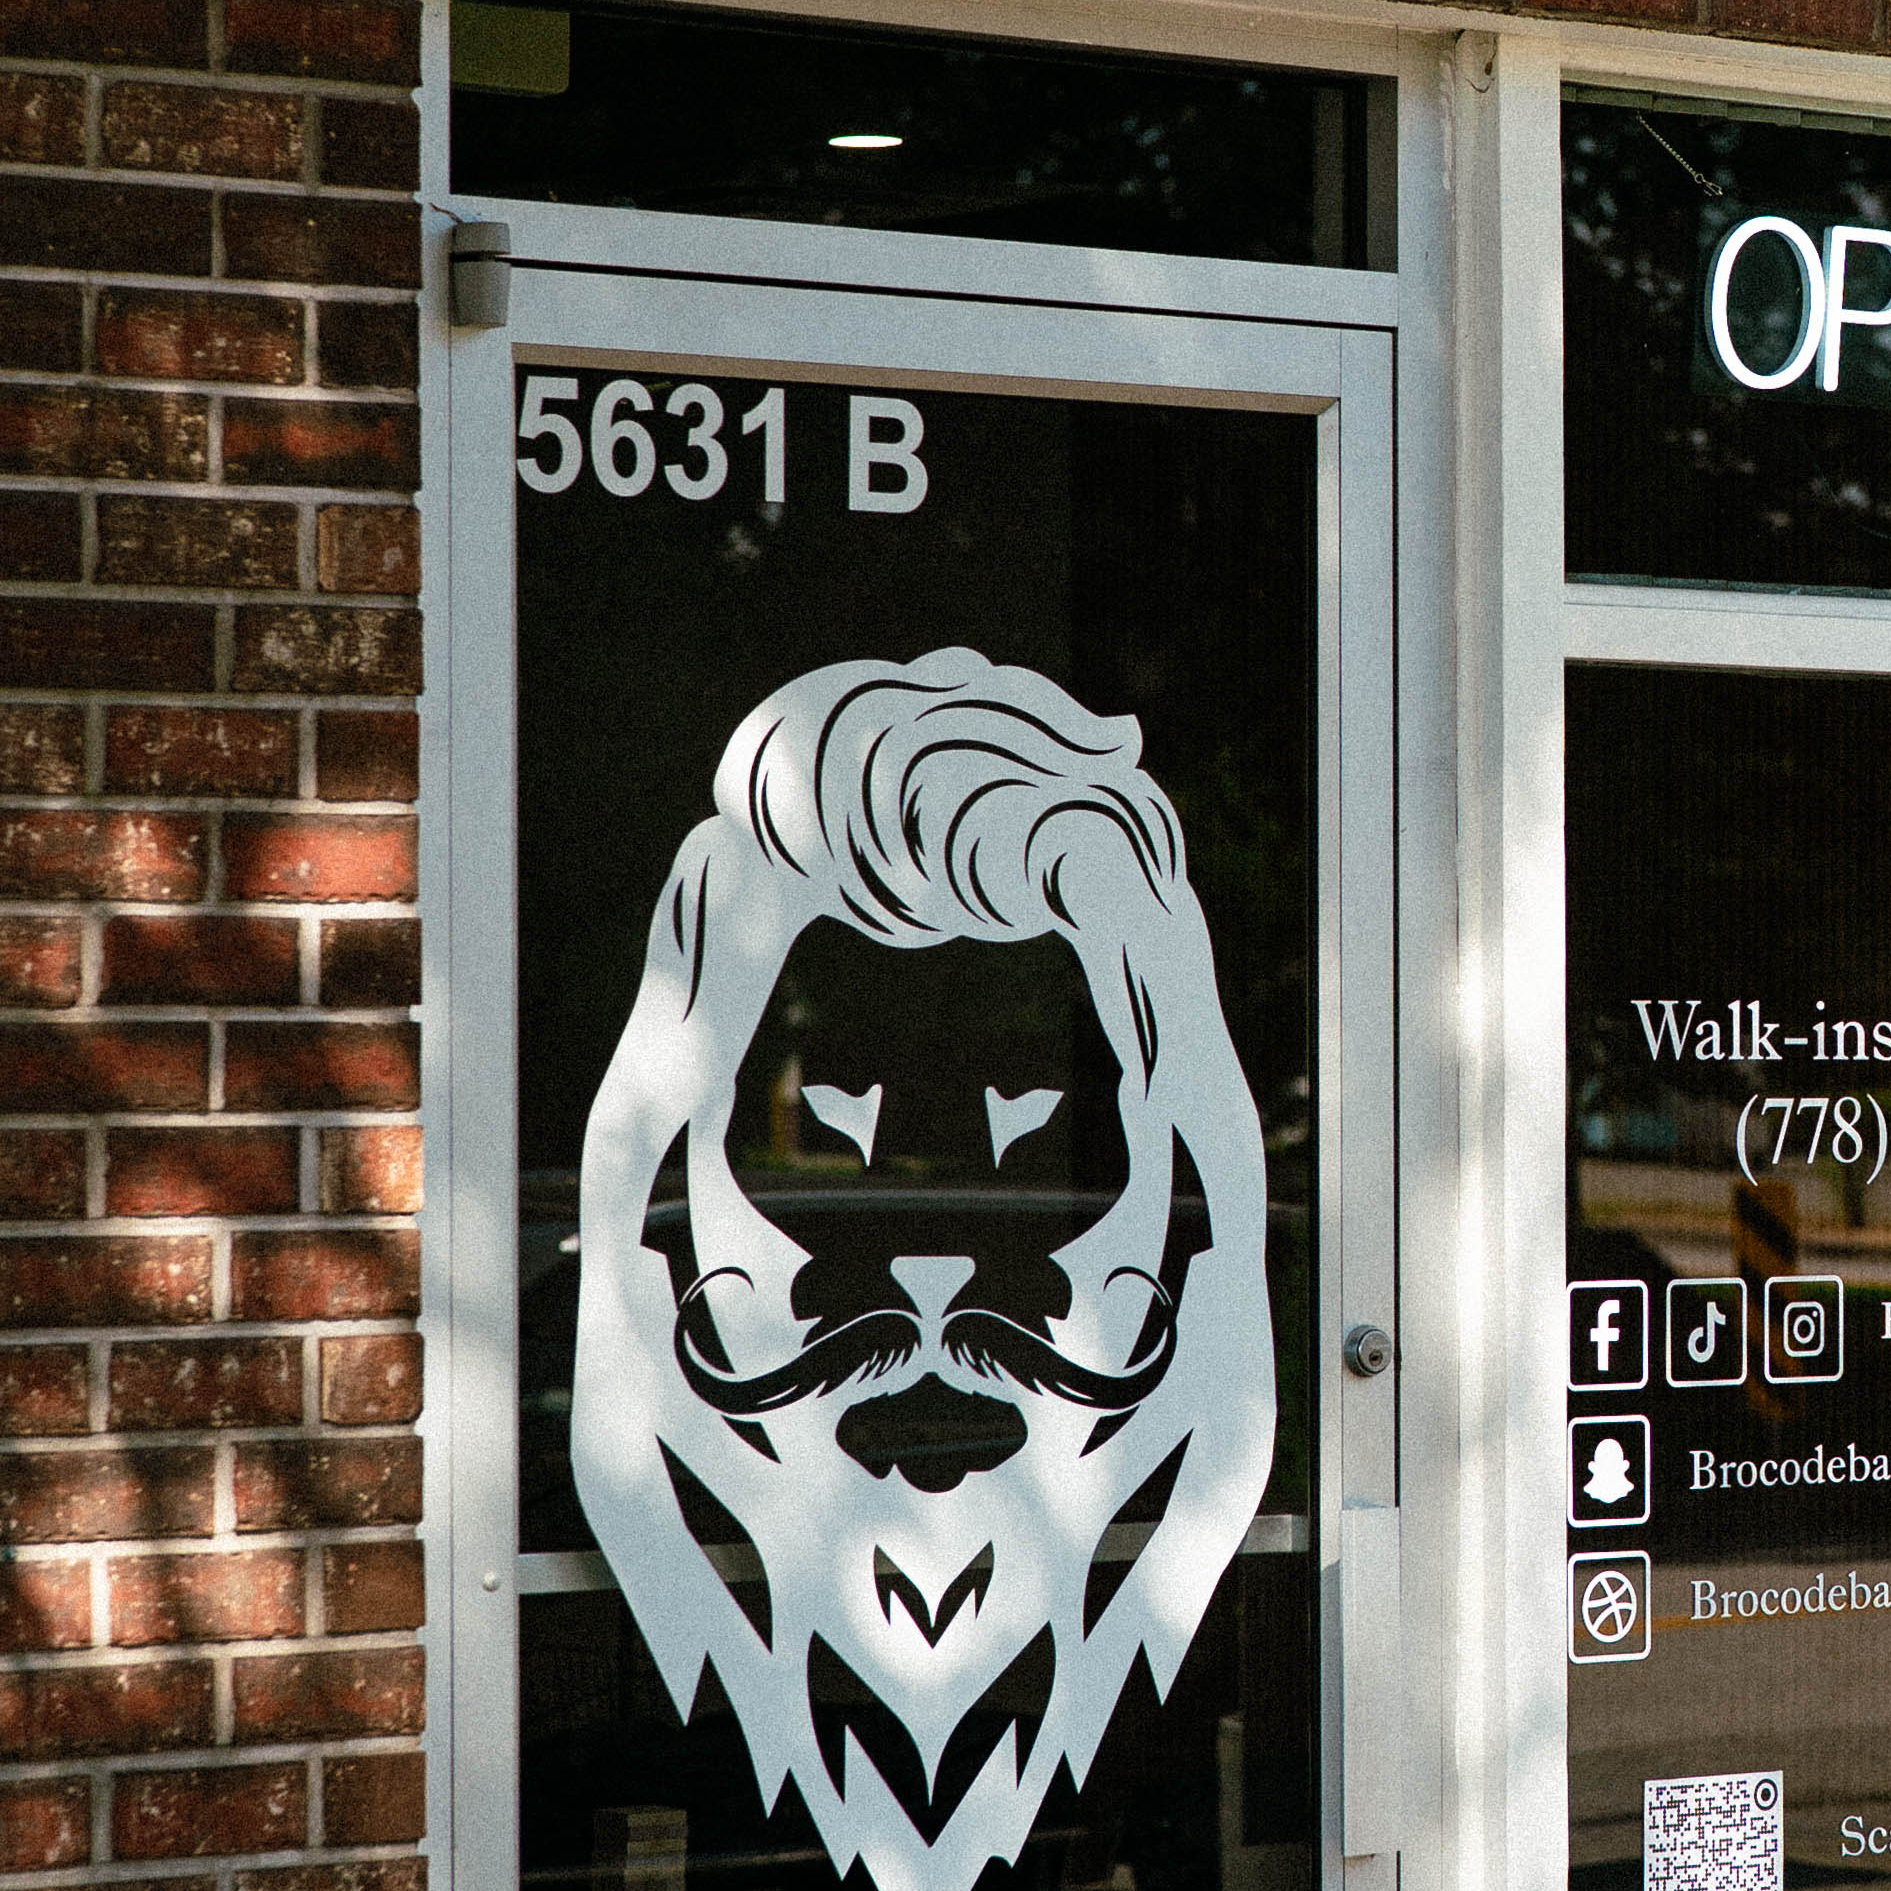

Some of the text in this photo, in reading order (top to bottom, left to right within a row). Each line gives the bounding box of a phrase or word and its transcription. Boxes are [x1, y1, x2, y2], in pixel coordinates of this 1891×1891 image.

[516, 376, 929, 513] 5631 B
[1735, 1093, 1889, 1187] (778)
